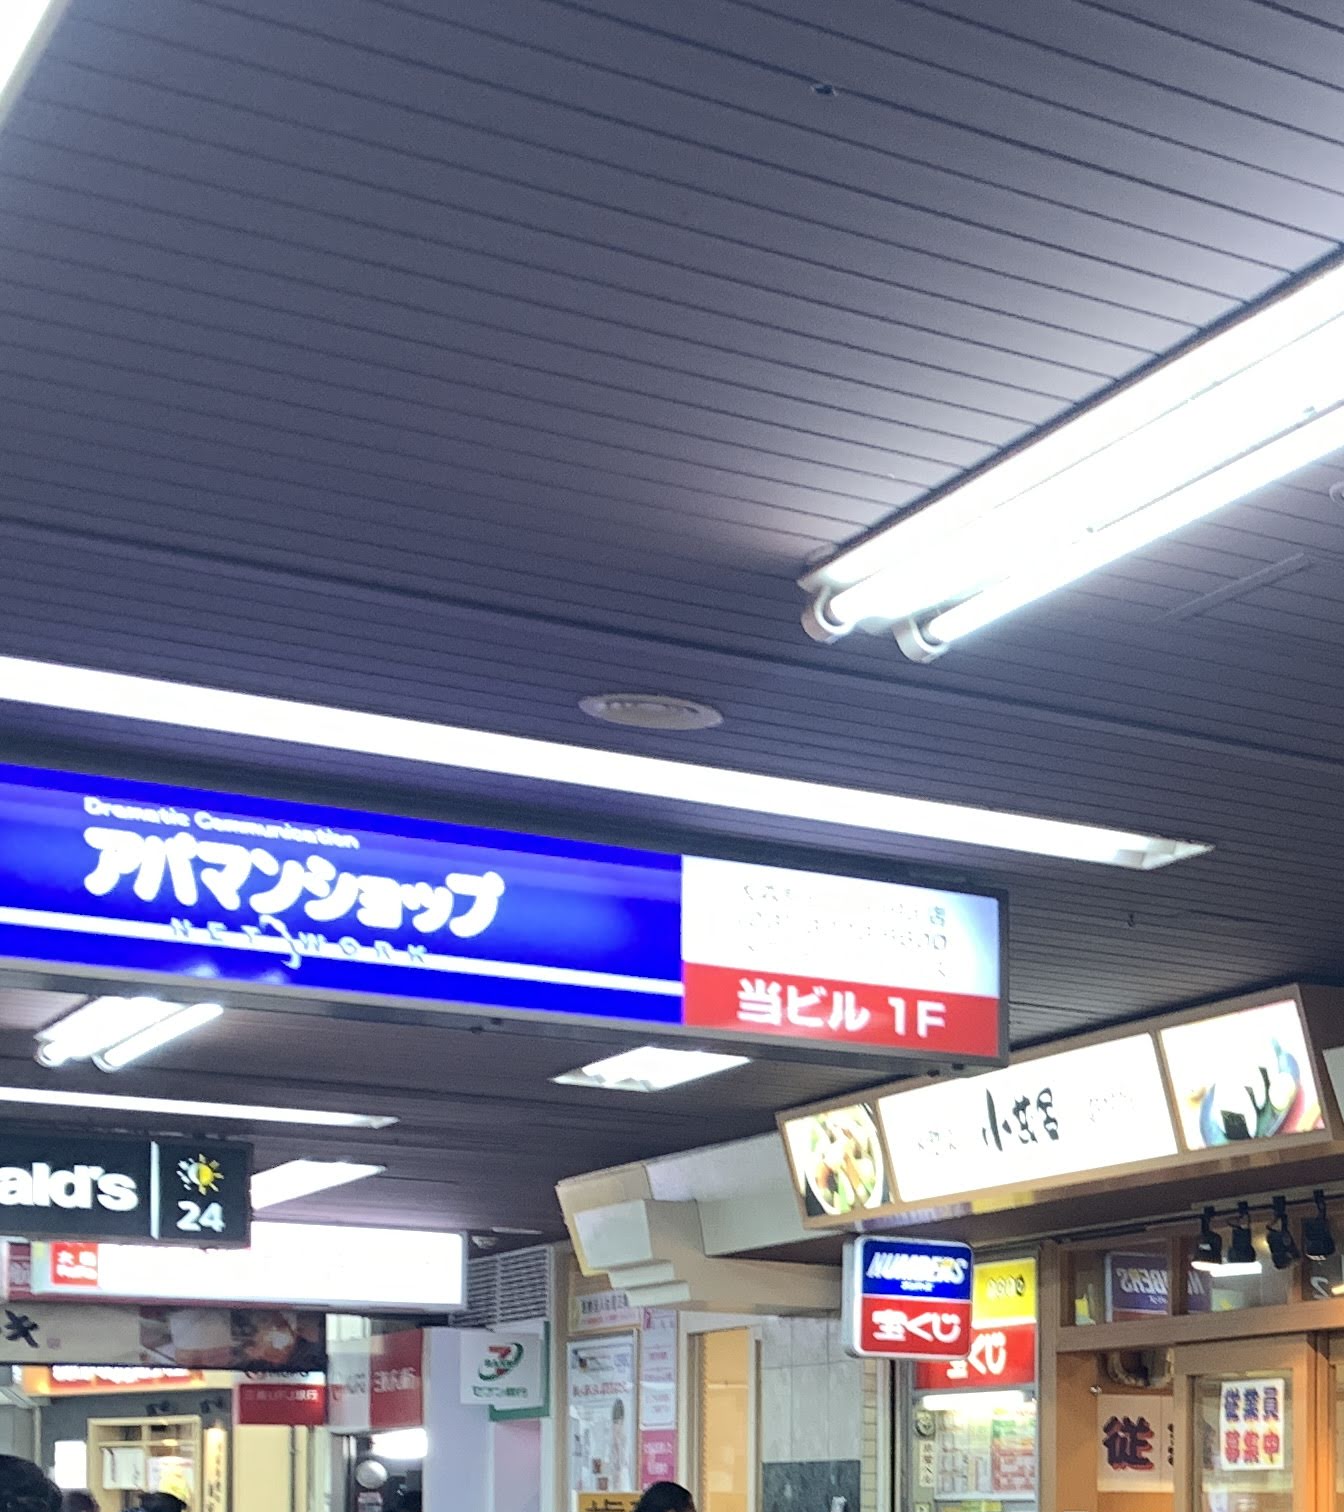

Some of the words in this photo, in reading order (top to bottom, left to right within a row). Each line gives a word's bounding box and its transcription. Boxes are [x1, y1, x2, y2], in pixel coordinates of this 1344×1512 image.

[83, 796, 191, 828] Dramatic
[83, 826, 505, 938] アパマンショップ
[737, 978, 871, 1031] 当ビル
[888, 996, 946, 1038] 1F
[176, 1201, 225, 1234] 24
[865, 1251, 968, 1285] NUMBERS
[871, 1309, 961, 1343] 宝くじ
